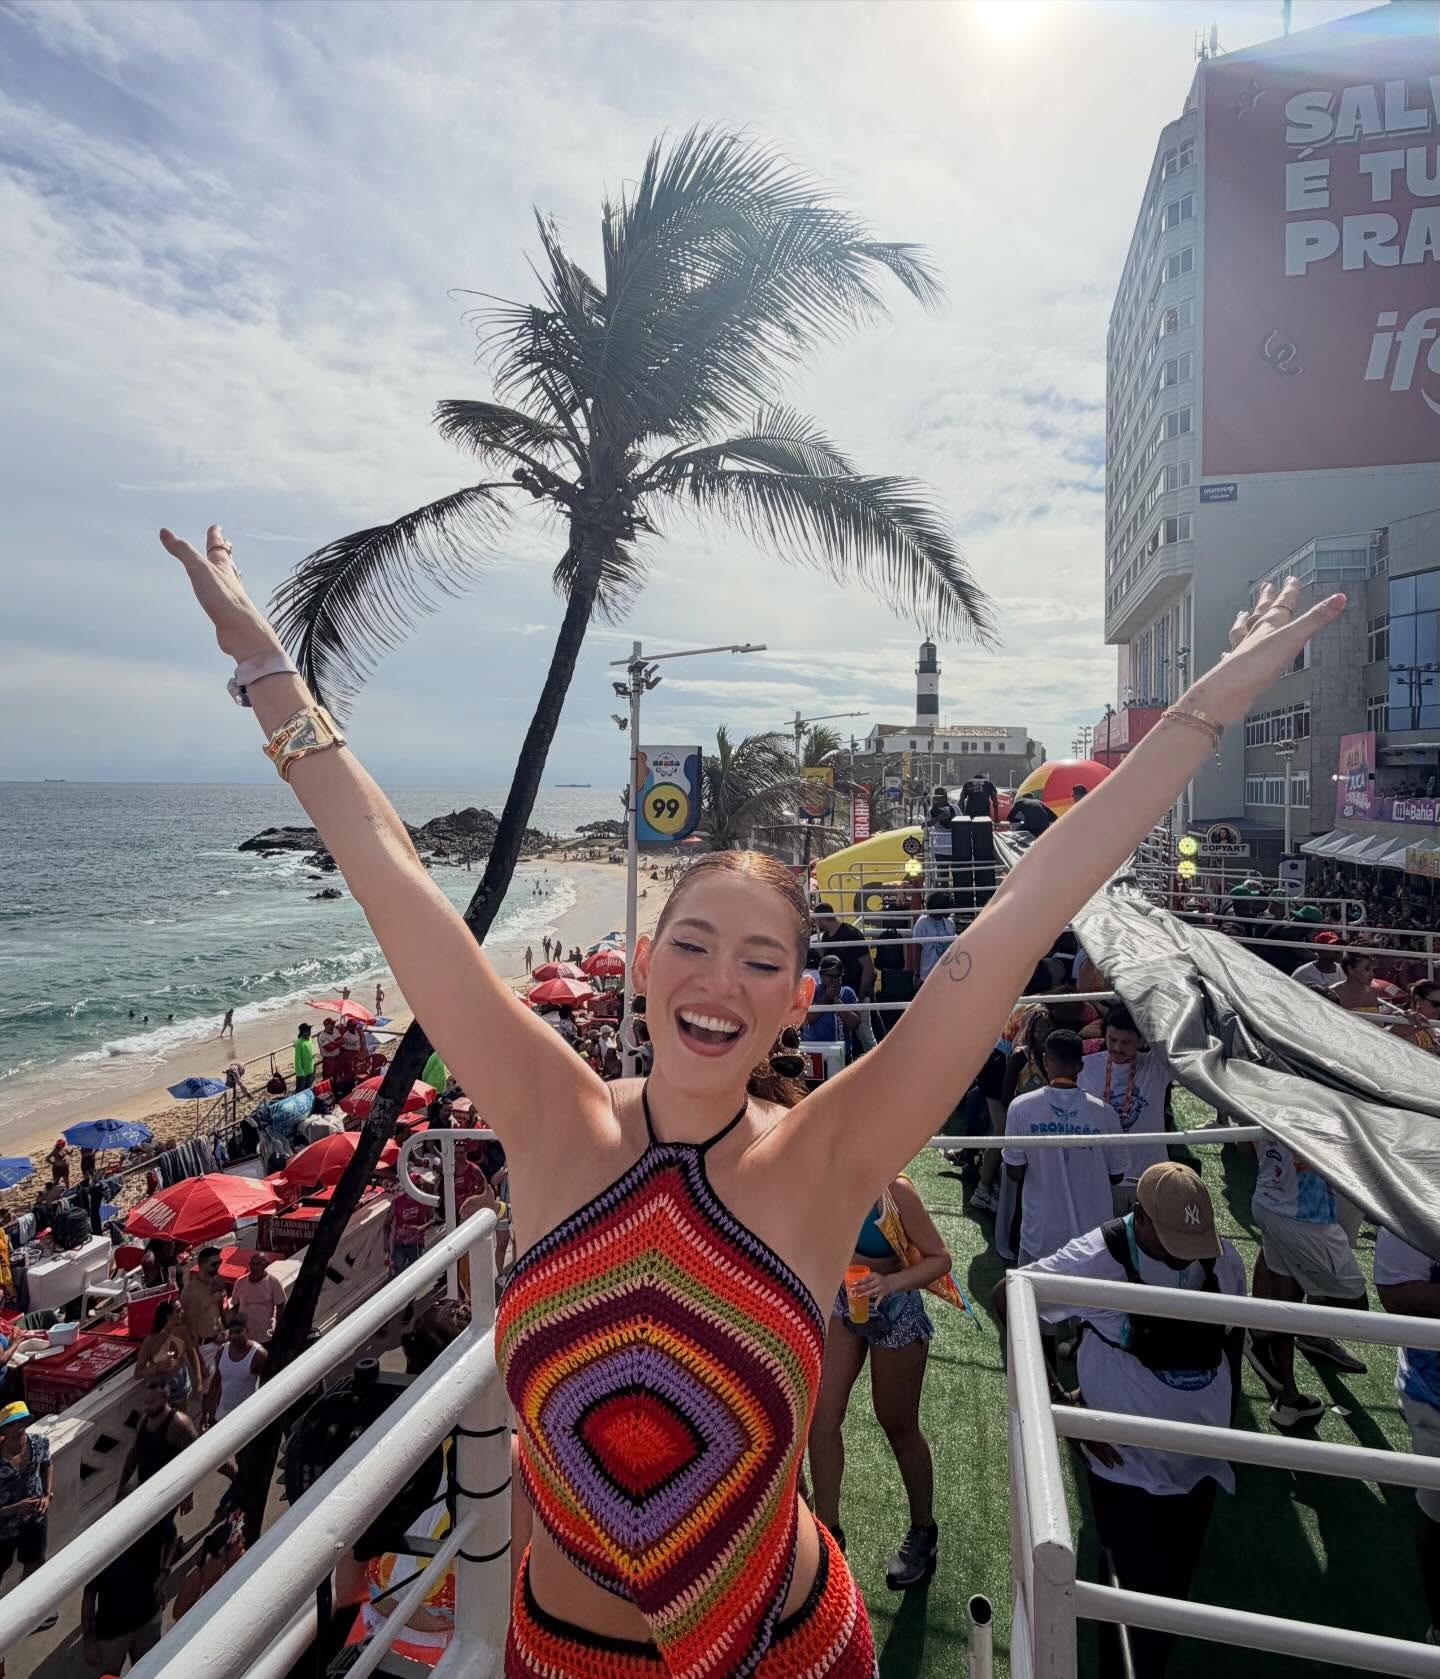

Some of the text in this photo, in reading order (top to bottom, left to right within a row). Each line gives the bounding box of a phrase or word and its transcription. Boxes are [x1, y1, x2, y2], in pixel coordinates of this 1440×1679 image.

[1284, 77, 1440, 147] SAL
[1285, 147, 1330, 212] É
[652, 799, 680, 818] 99
[1410, 804, 1434, 820] Bahia
[1201, 844, 1247, 852] COPYART
[1184, 1204, 1201, 1225] NY
